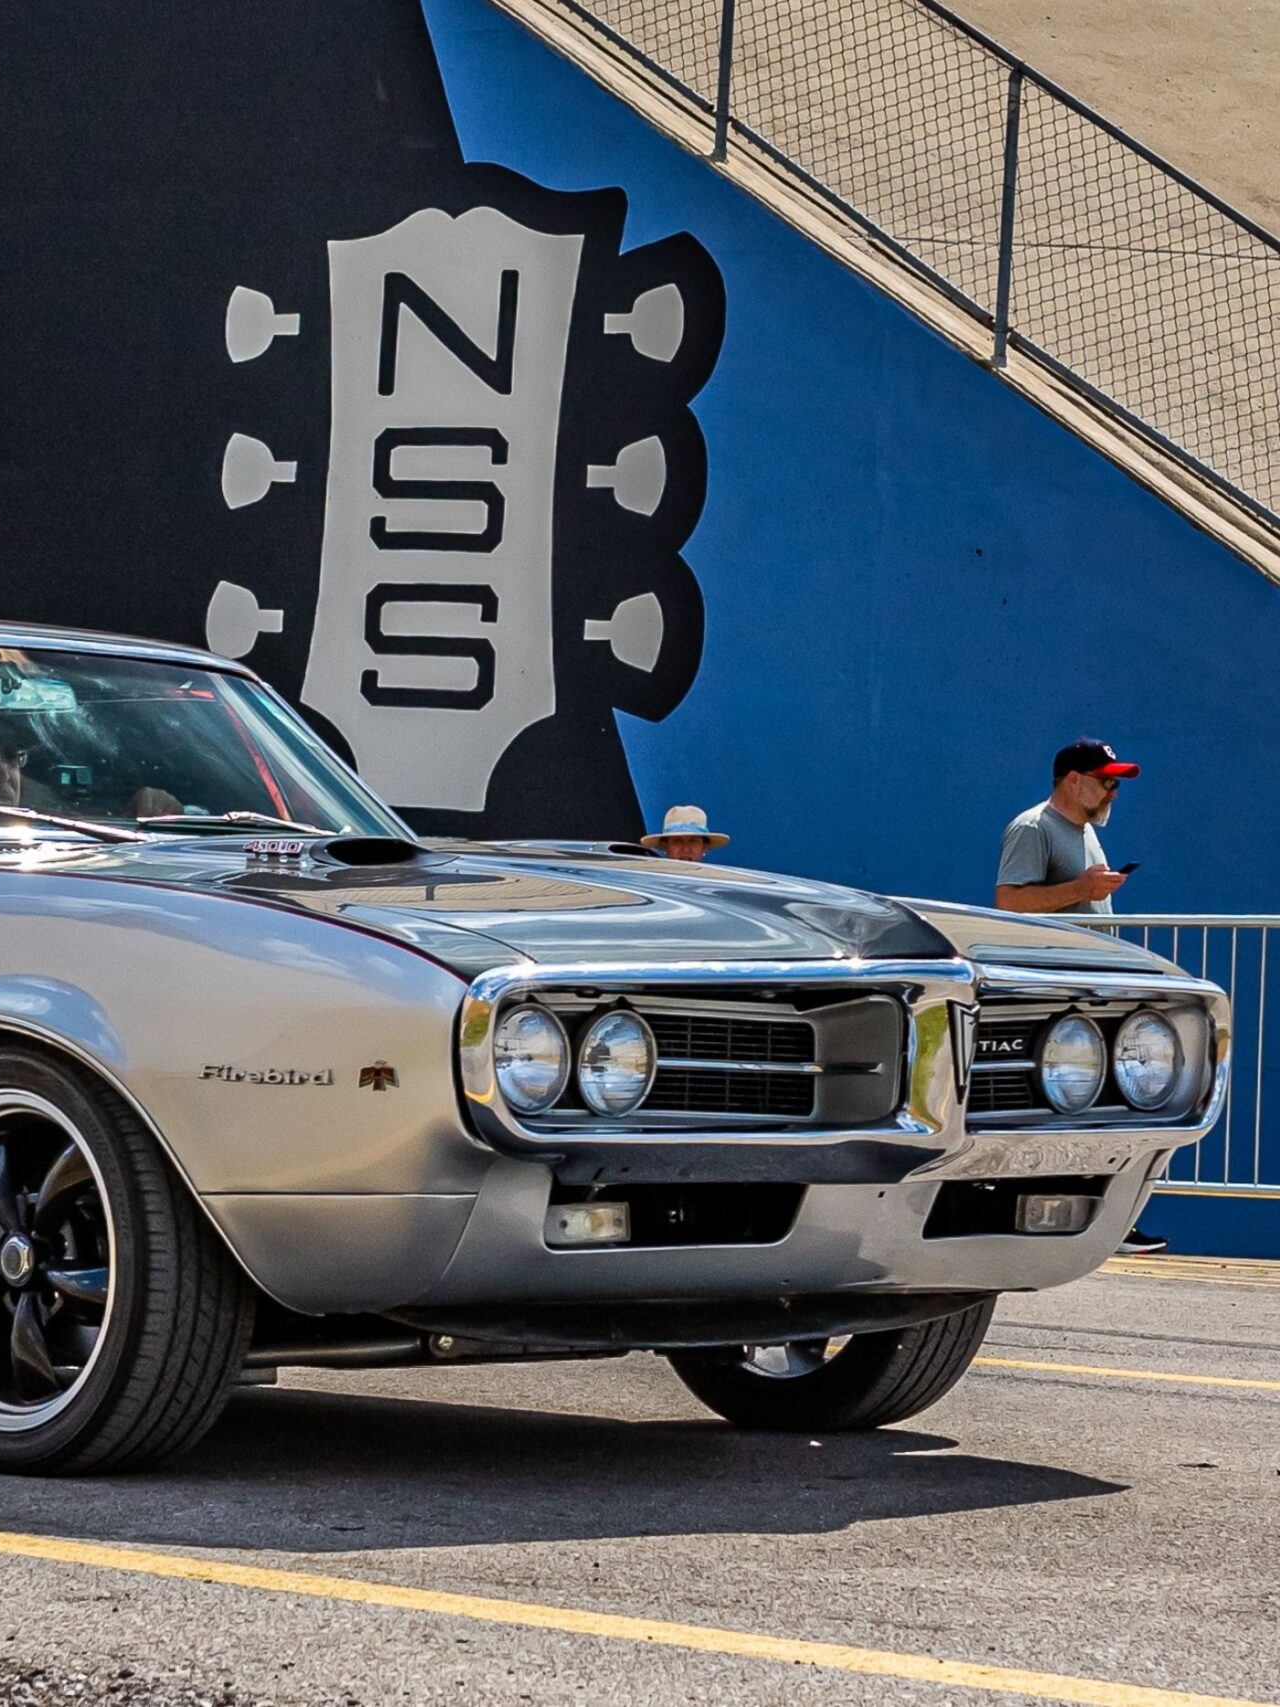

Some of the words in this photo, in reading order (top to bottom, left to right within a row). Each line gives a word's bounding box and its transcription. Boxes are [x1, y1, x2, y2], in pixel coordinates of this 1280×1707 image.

[360, 268, 520, 712] NSS
[242, 840, 304, 854] 400
[198, 1063, 335, 1085] Firebird
